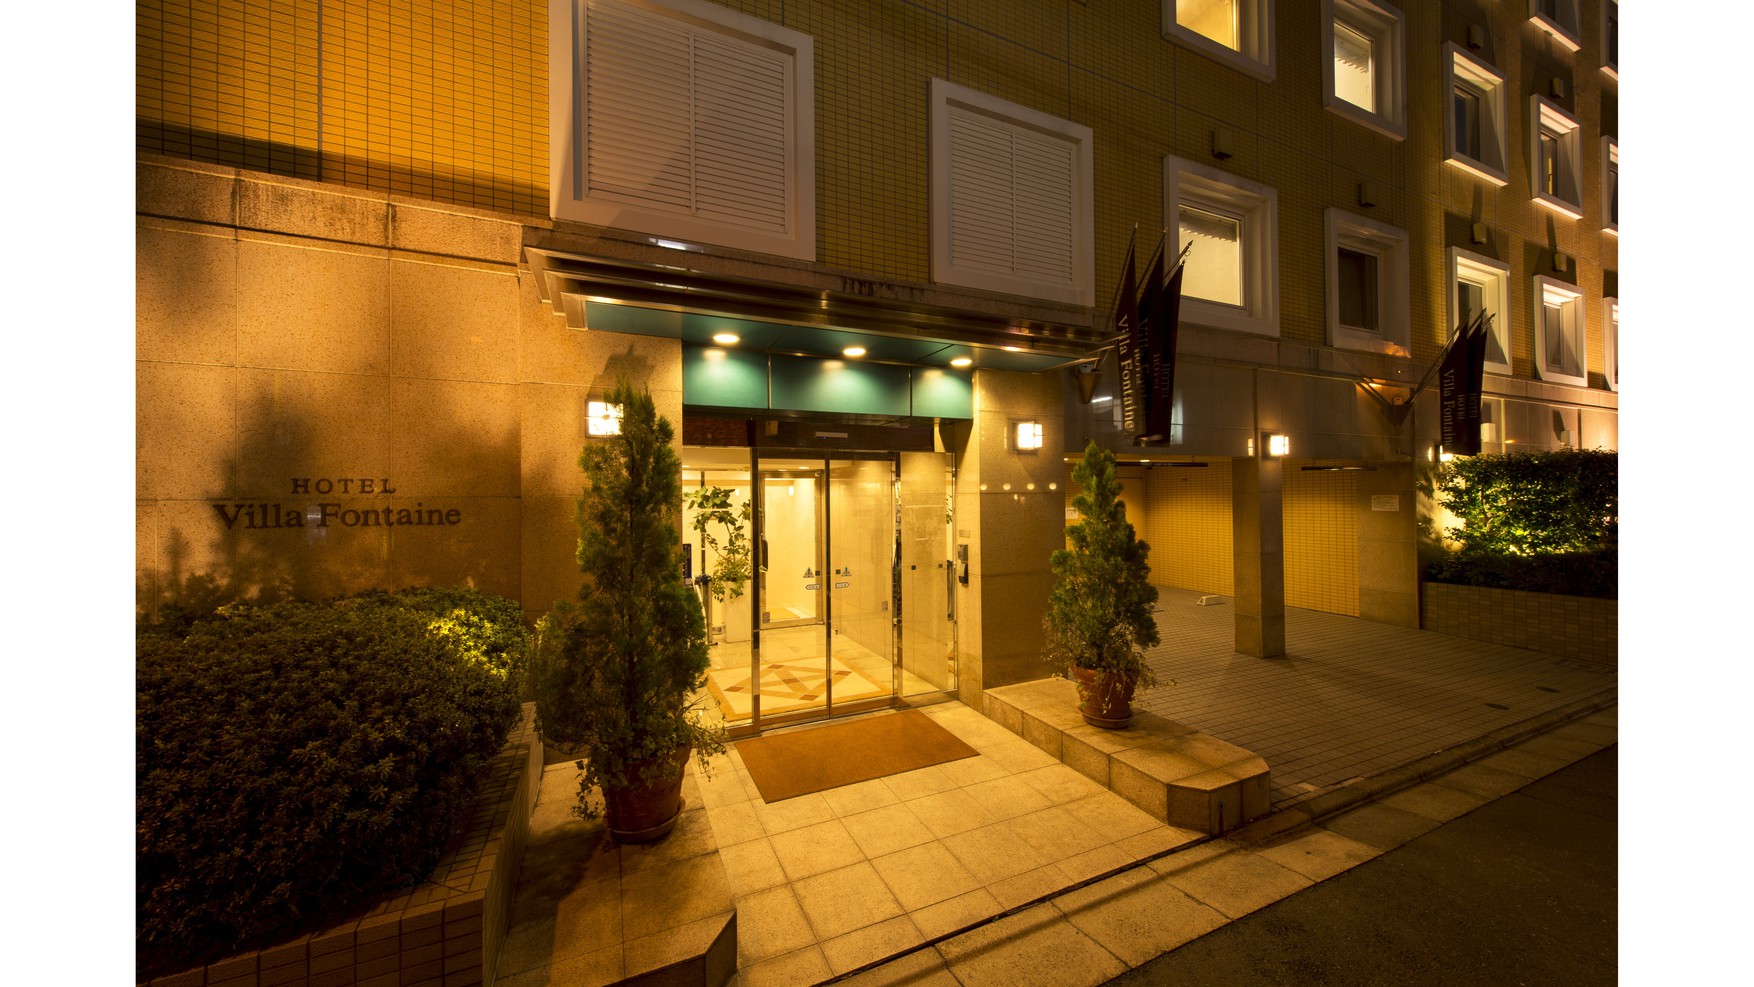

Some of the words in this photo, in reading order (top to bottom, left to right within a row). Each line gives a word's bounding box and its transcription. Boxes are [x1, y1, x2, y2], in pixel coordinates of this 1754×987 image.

[1120, 358, 1137, 431] Fontaine
[1443, 368, 1455, 397] Villa
[290, 478, 397, 495] HOTEL
[213, 502, 304, 530] Villa
[317, 501, 462, 527] Fontaine
